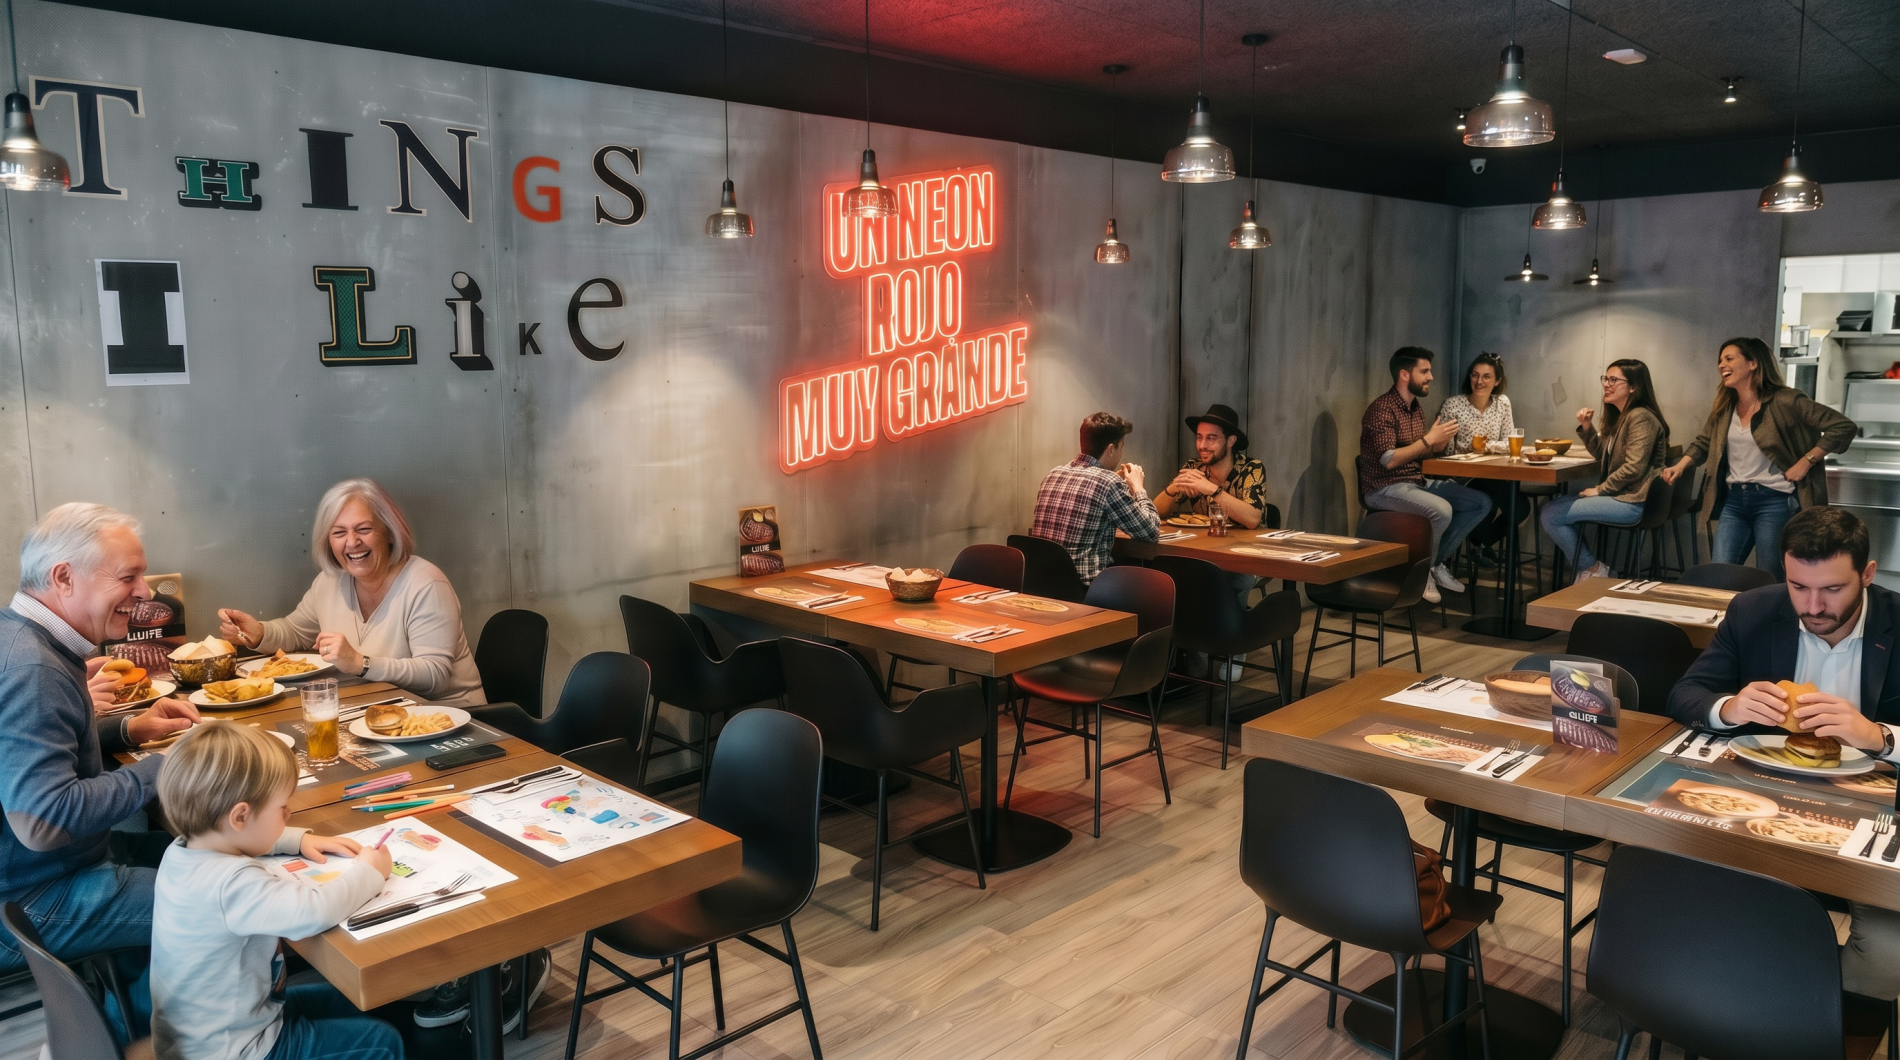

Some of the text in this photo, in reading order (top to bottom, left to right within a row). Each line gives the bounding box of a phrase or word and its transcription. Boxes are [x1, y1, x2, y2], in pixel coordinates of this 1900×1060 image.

[897, 171, 993, 261] NEON
[101, 260, 187, 375] I
[868, 260, 962, 356] ROJO
[785, 365, 880, 467] MUY
